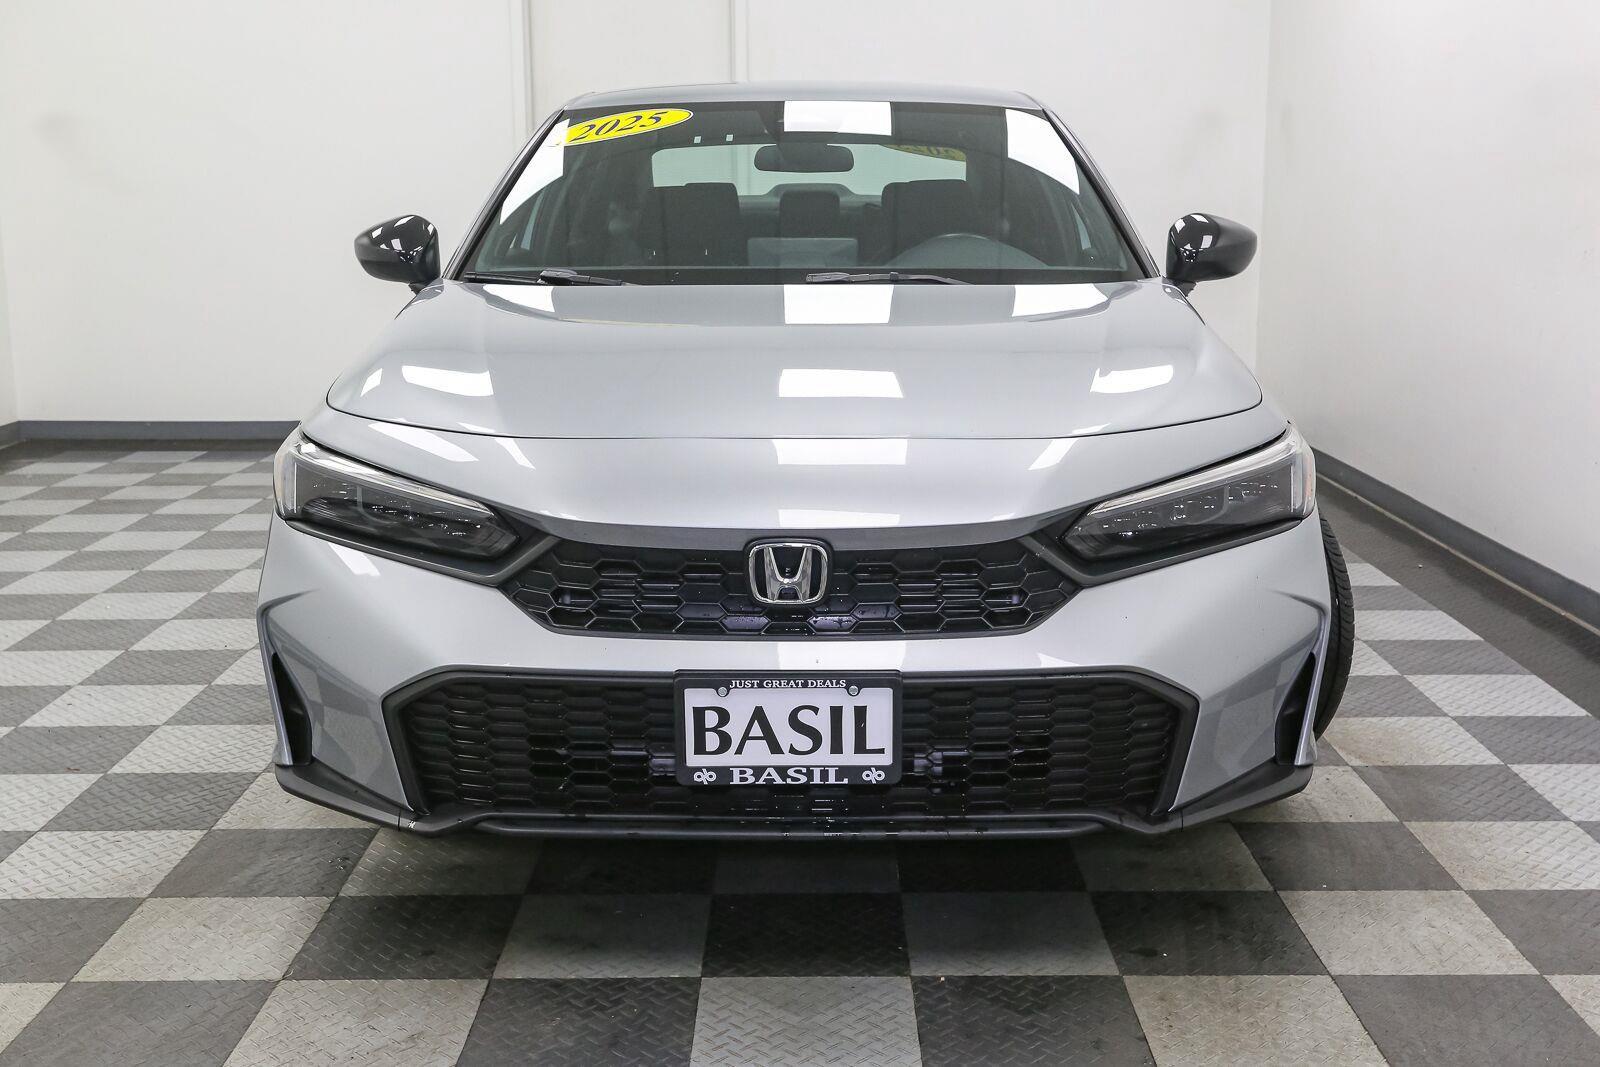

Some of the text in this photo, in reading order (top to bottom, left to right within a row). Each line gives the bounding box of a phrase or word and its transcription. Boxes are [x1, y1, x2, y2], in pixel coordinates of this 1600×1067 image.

[568, 111, 669, 143] 2025
[729, 679, 847, 688] JUST GREAT DEALS
[692, 704, 886, 756] BASIL
[729, 767, 849, 785] BASIL
